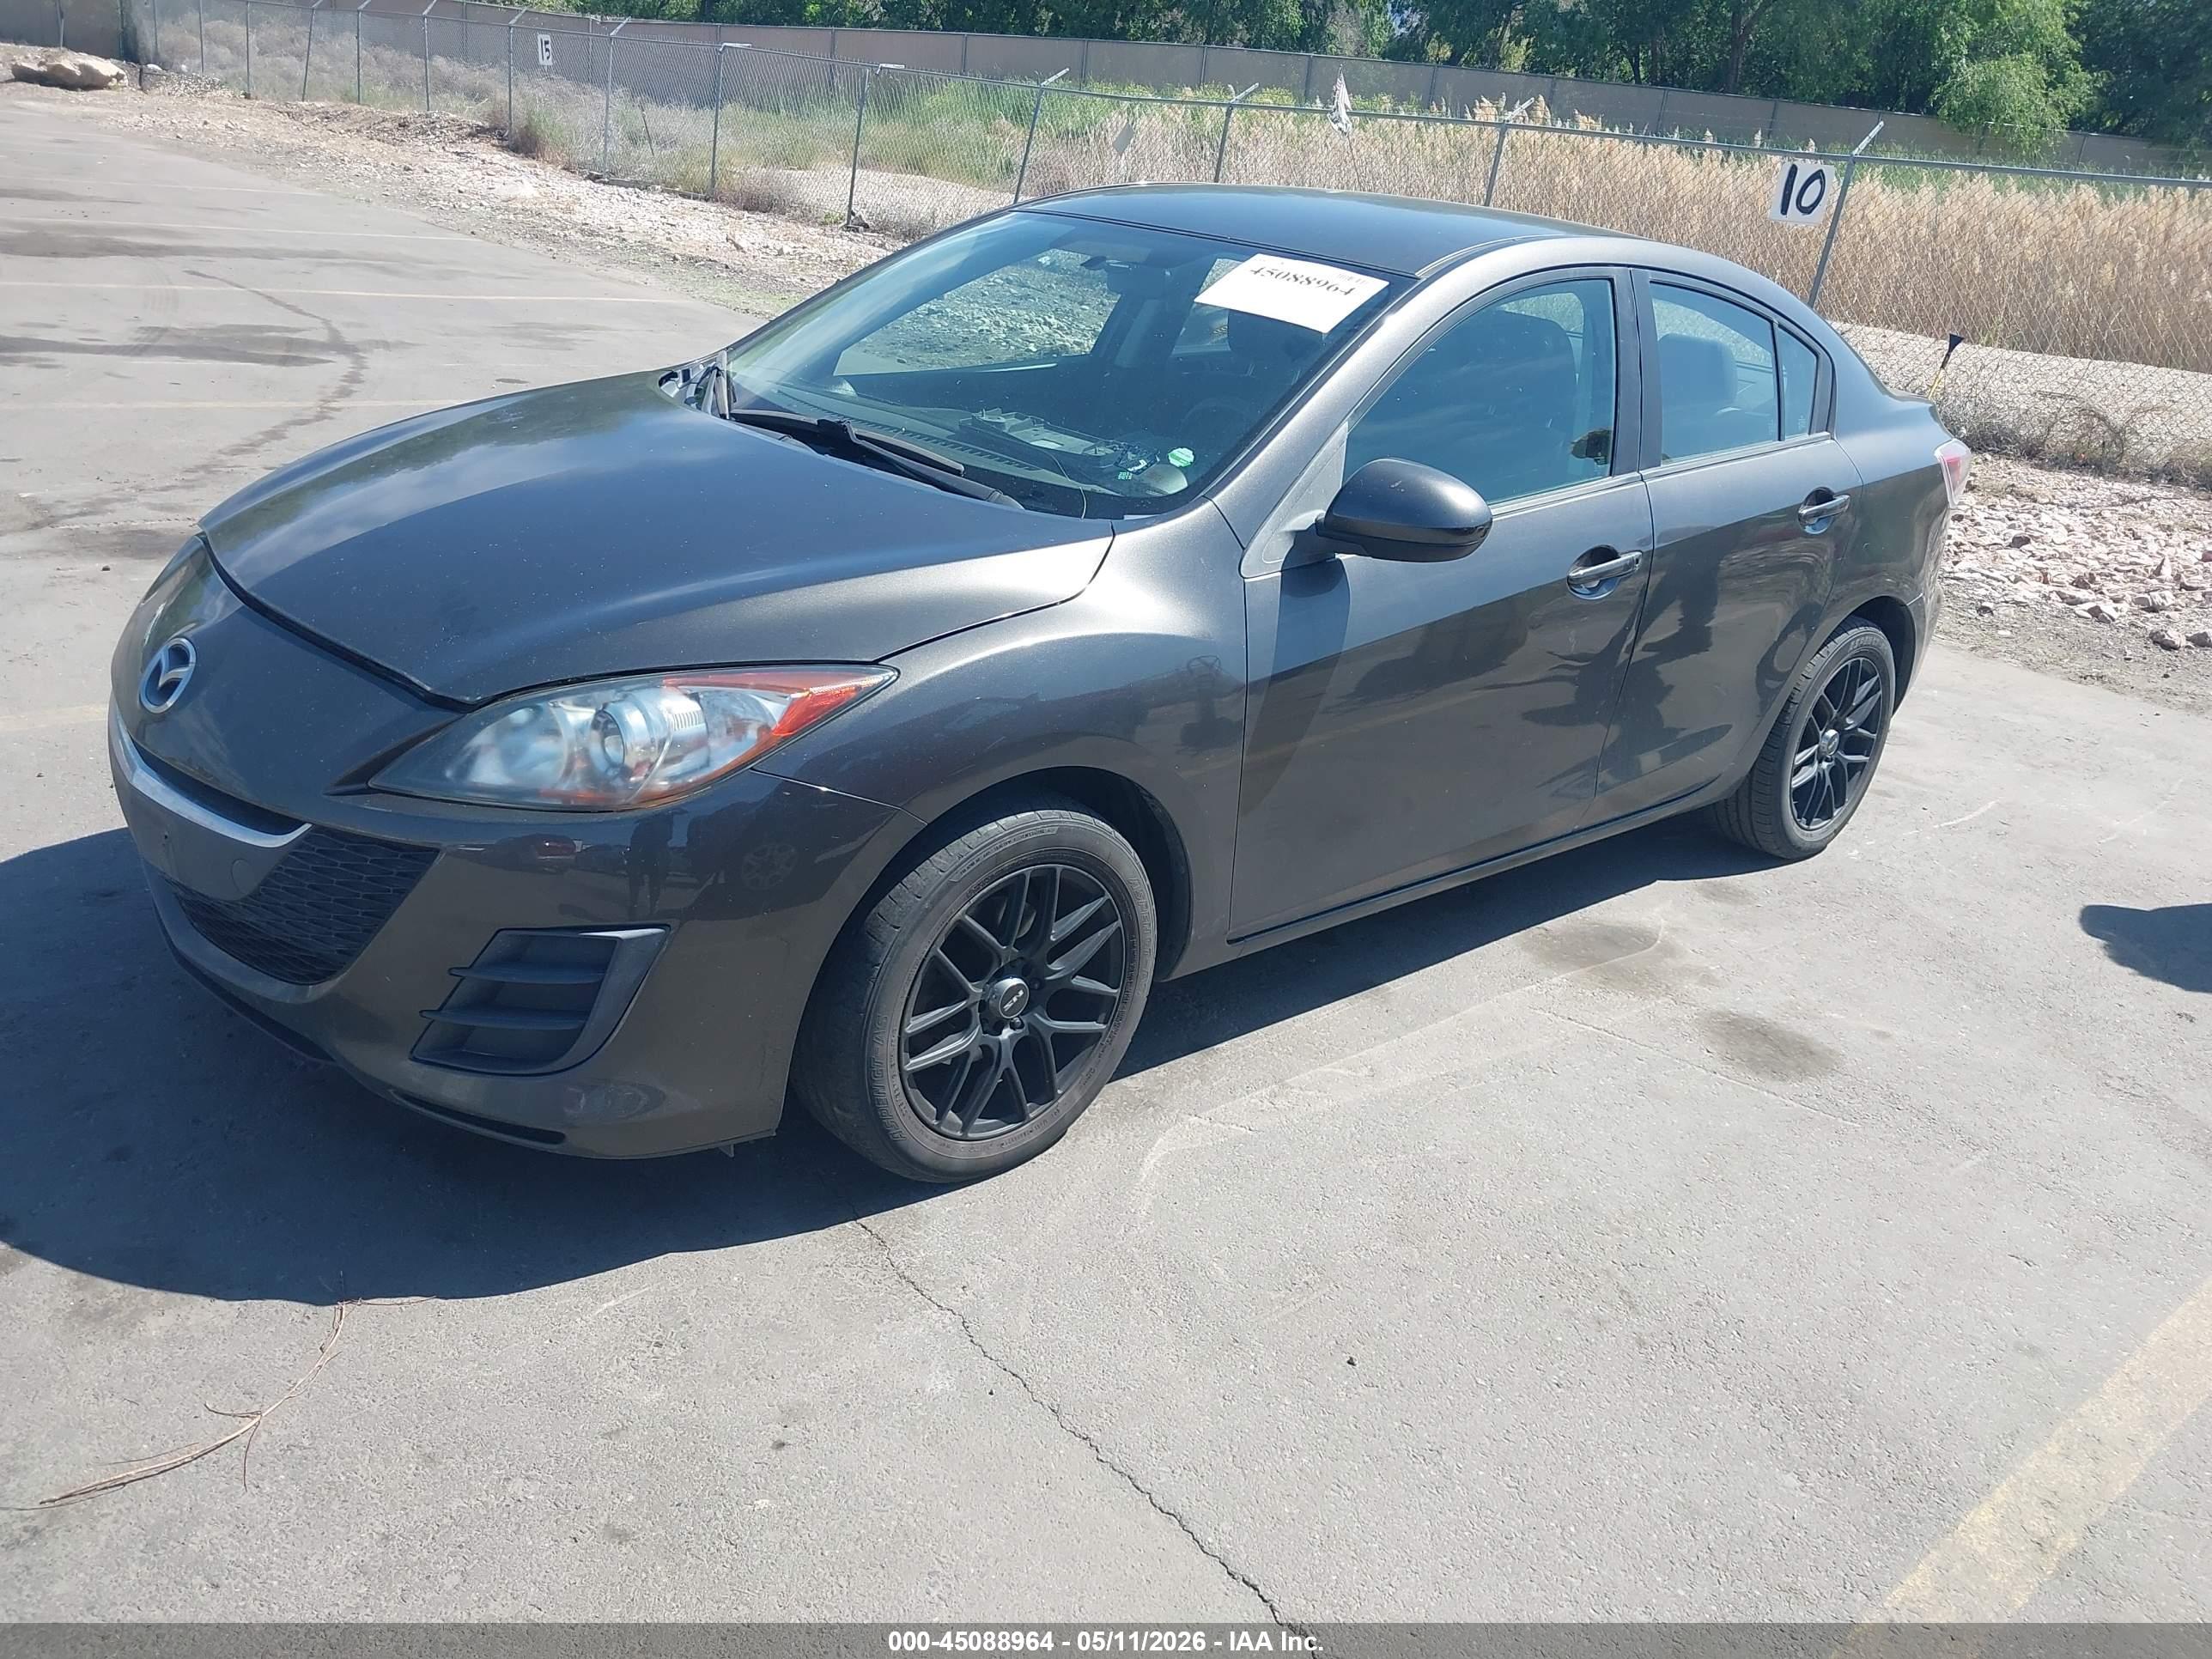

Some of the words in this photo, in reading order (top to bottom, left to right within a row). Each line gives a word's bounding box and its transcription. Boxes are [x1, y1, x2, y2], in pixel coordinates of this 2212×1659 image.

[540, 38, 551, 61] 15
[1780, 163, 1826, 216] 10
[1249, 265, 1356, 296] 45088964
[871, 1085, 907, 1141] ASPEN
